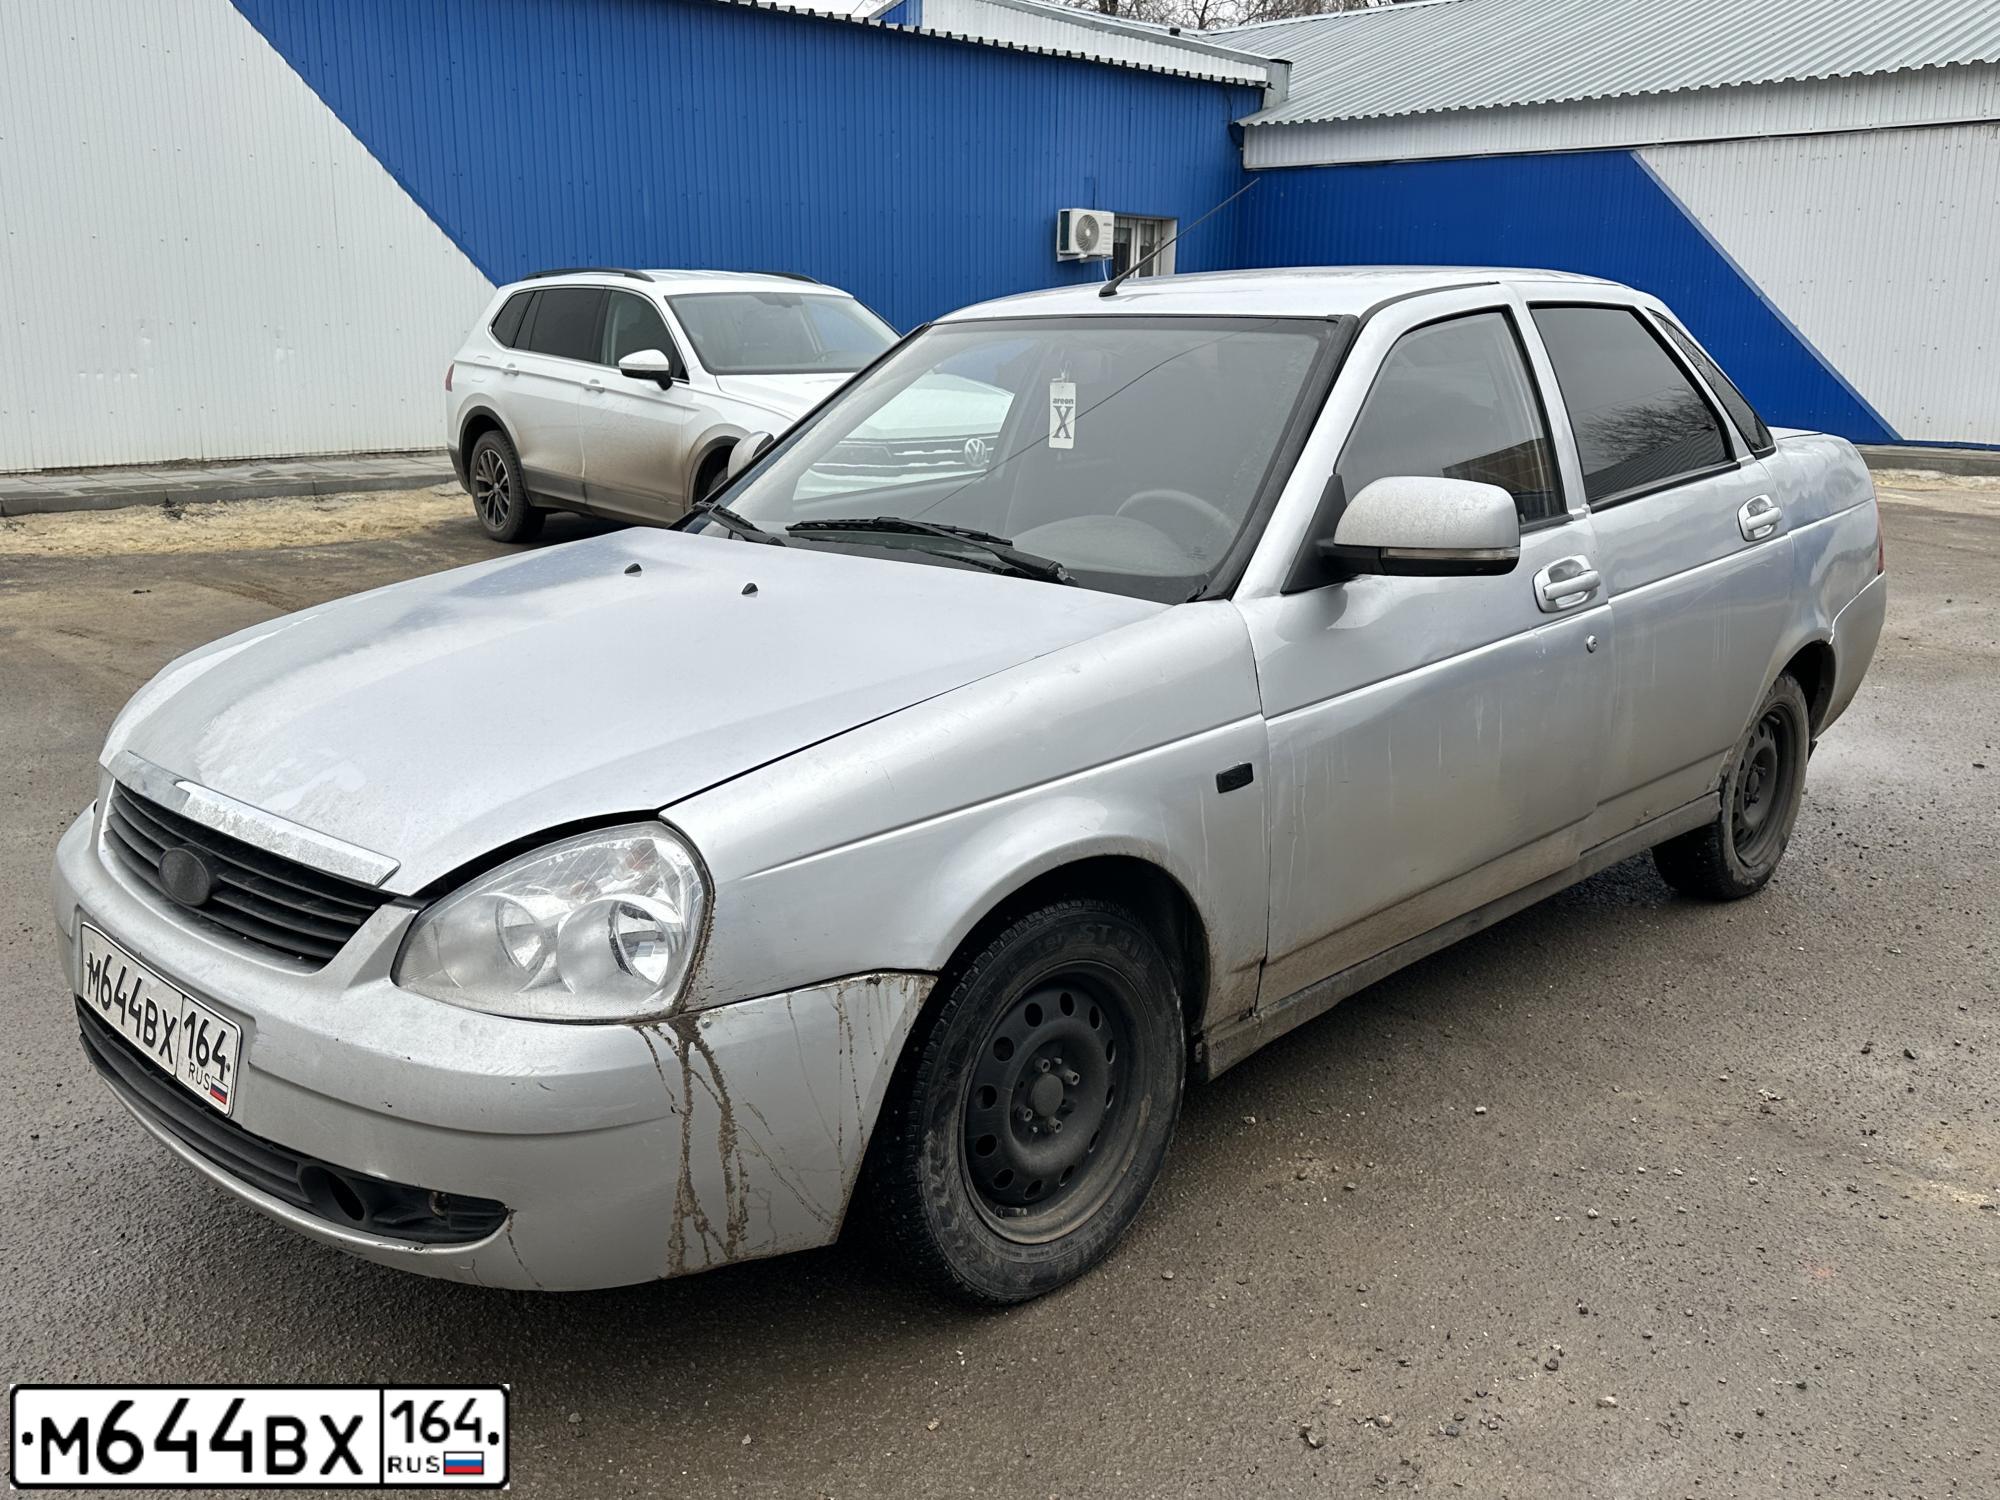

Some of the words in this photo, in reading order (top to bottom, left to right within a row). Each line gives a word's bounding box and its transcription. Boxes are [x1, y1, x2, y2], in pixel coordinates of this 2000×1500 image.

[1052, 405, 1074, 439] X
[183, 1010, 226, 1081] 164
[189, 1062, 210, 1091] RUS
